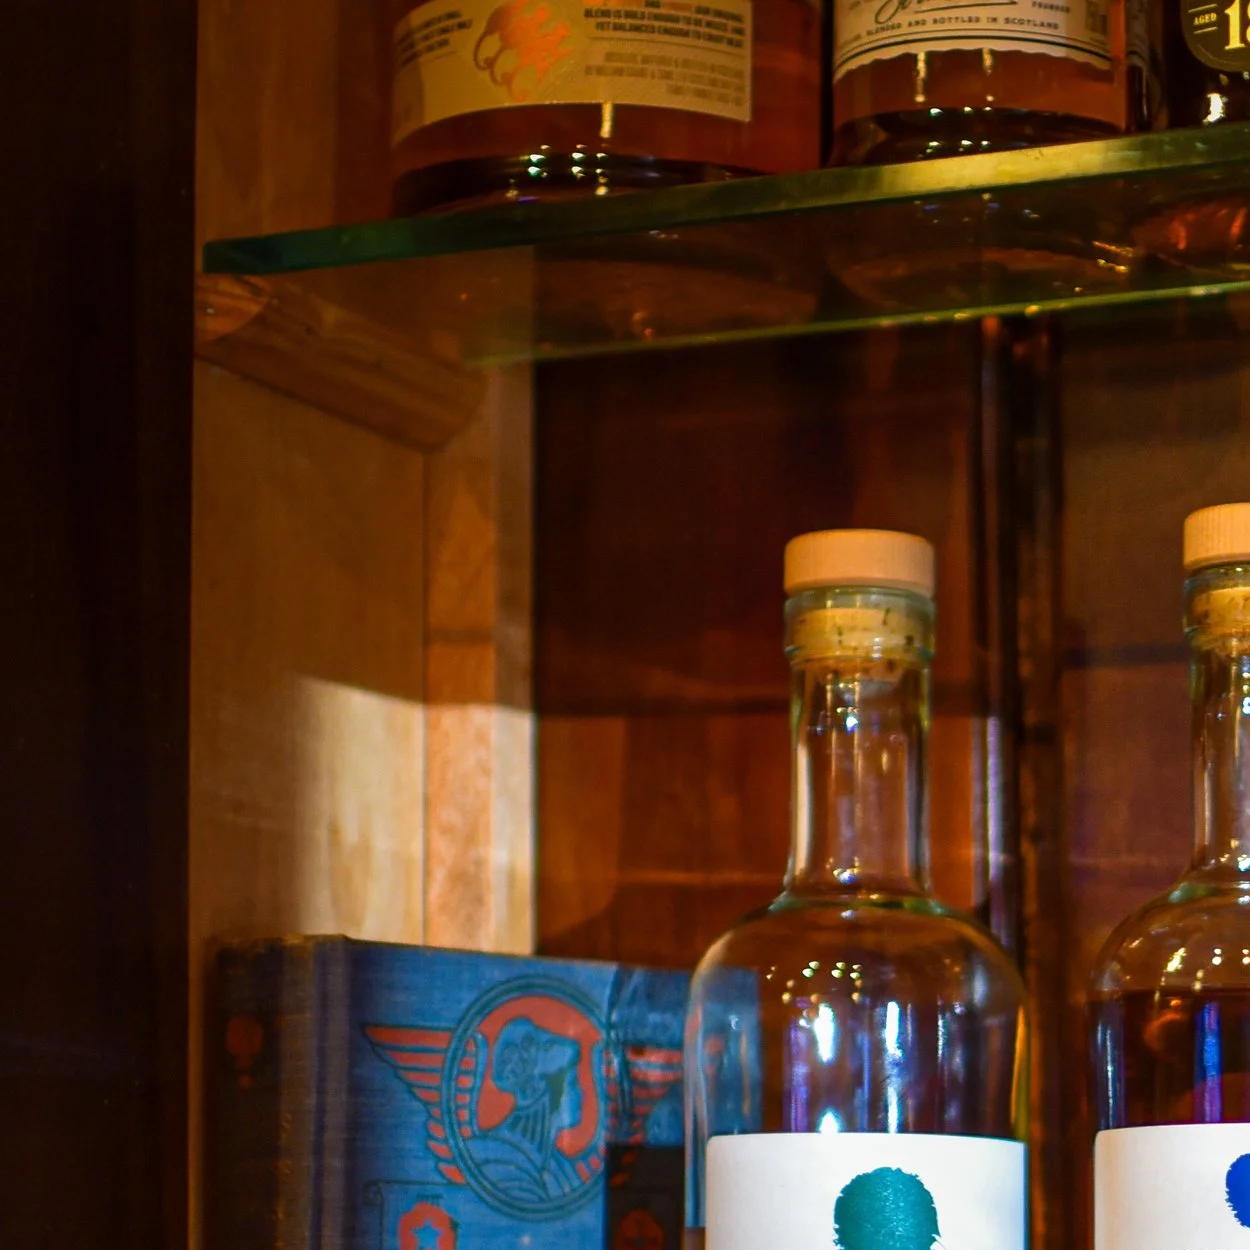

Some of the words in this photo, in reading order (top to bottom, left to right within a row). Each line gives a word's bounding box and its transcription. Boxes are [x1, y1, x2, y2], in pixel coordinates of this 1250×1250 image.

[933, 16, 980, 25] BOTTLED
[1004, 17, 1060, 31] SCOTLAND
[1193, 12, 1217, 25] AGED
